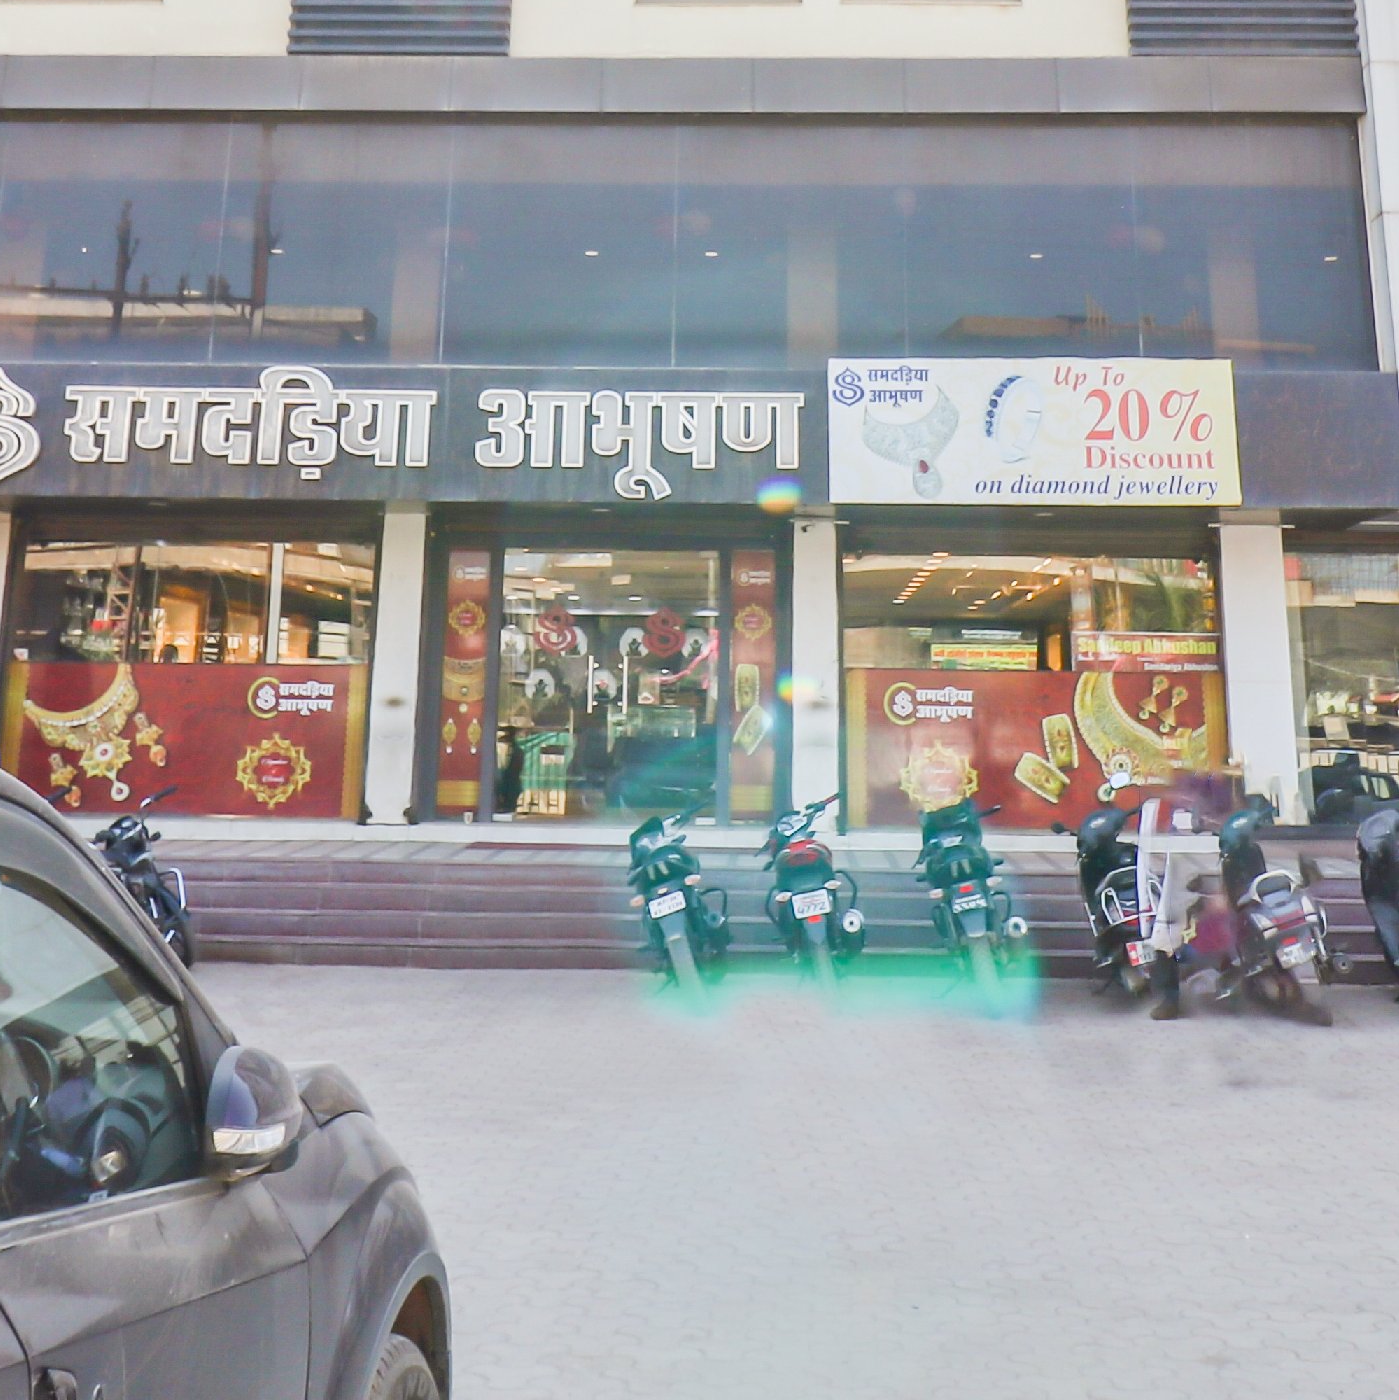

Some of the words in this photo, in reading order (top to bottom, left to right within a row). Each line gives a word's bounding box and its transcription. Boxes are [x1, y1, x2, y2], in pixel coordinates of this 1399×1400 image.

[1053, 366, 1088, 391] Up
[1100, 366, 1125, 386] To
[1084, 389, 1213, 442] 20%
[64, 365, 437, 481] समदड़िया
[475, 389, 804, 501] आभूषण
[1084, 445, 1215, 470] Discount
[975, 479, 1002, 494] on
[1011, 475, 1111, 495] diamond
[1114, 475, 1218, 501] jewellery
